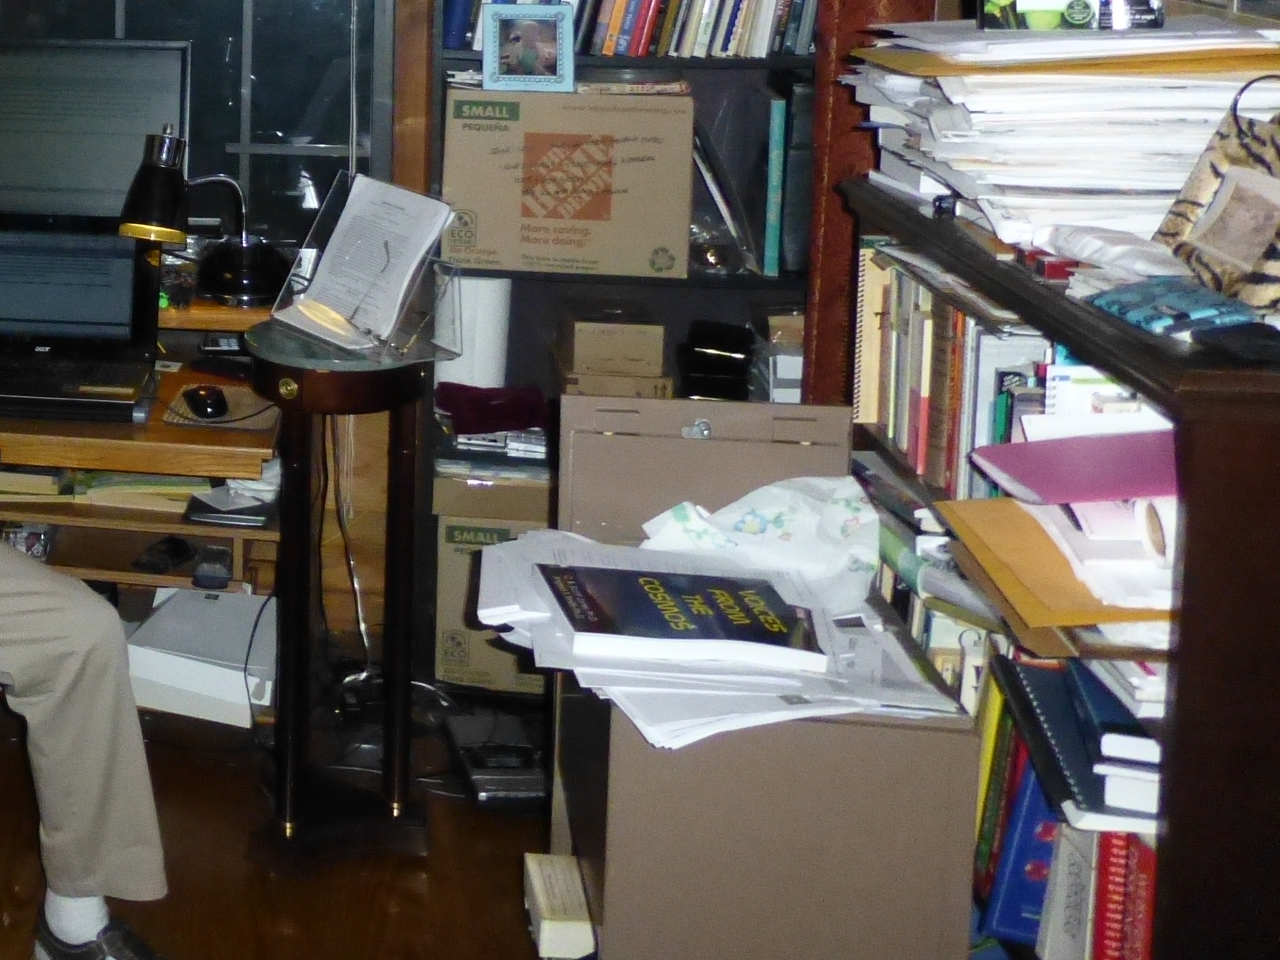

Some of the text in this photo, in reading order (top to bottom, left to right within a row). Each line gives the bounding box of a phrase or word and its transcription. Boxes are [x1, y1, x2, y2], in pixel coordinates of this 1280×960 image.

[462, 104, 509, 119] SMALL
[462, 122, 509, 132] PEQUEÑA
[451, 229, 473, 238] ECO
[520, 224, 550, 233] More
[521, 235, 550, 244] More
[454, 530, 498, 543] SMALL
[638, 577, 696, 631] COSMOS
[682, 594, 713, 617] THE
[707, 588, 751, 626] FROM
[738, 590, 787, 634] VOICES
